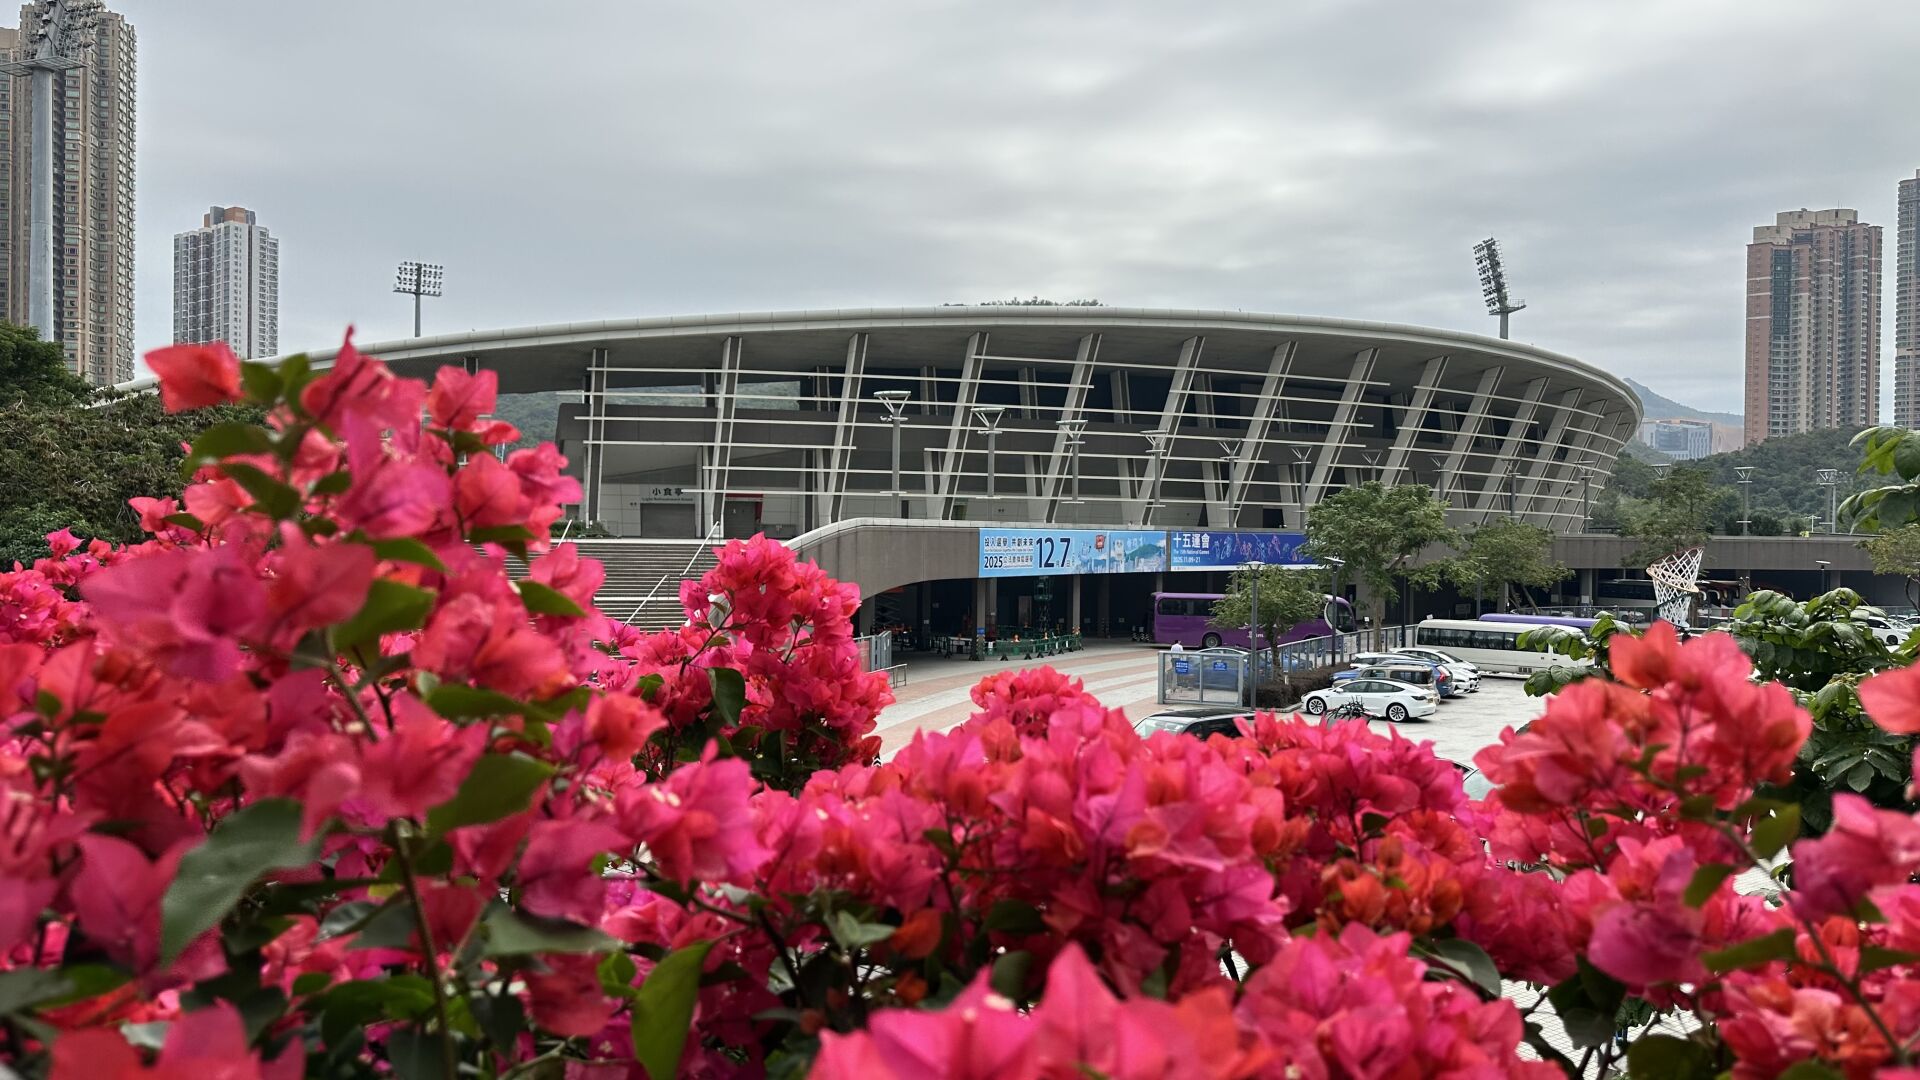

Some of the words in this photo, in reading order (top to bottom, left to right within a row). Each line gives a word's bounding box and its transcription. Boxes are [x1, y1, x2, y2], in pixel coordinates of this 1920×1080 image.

[1173, 532, 1210, 548] 十五運會
[984, 556, 1003, 568] 2025
